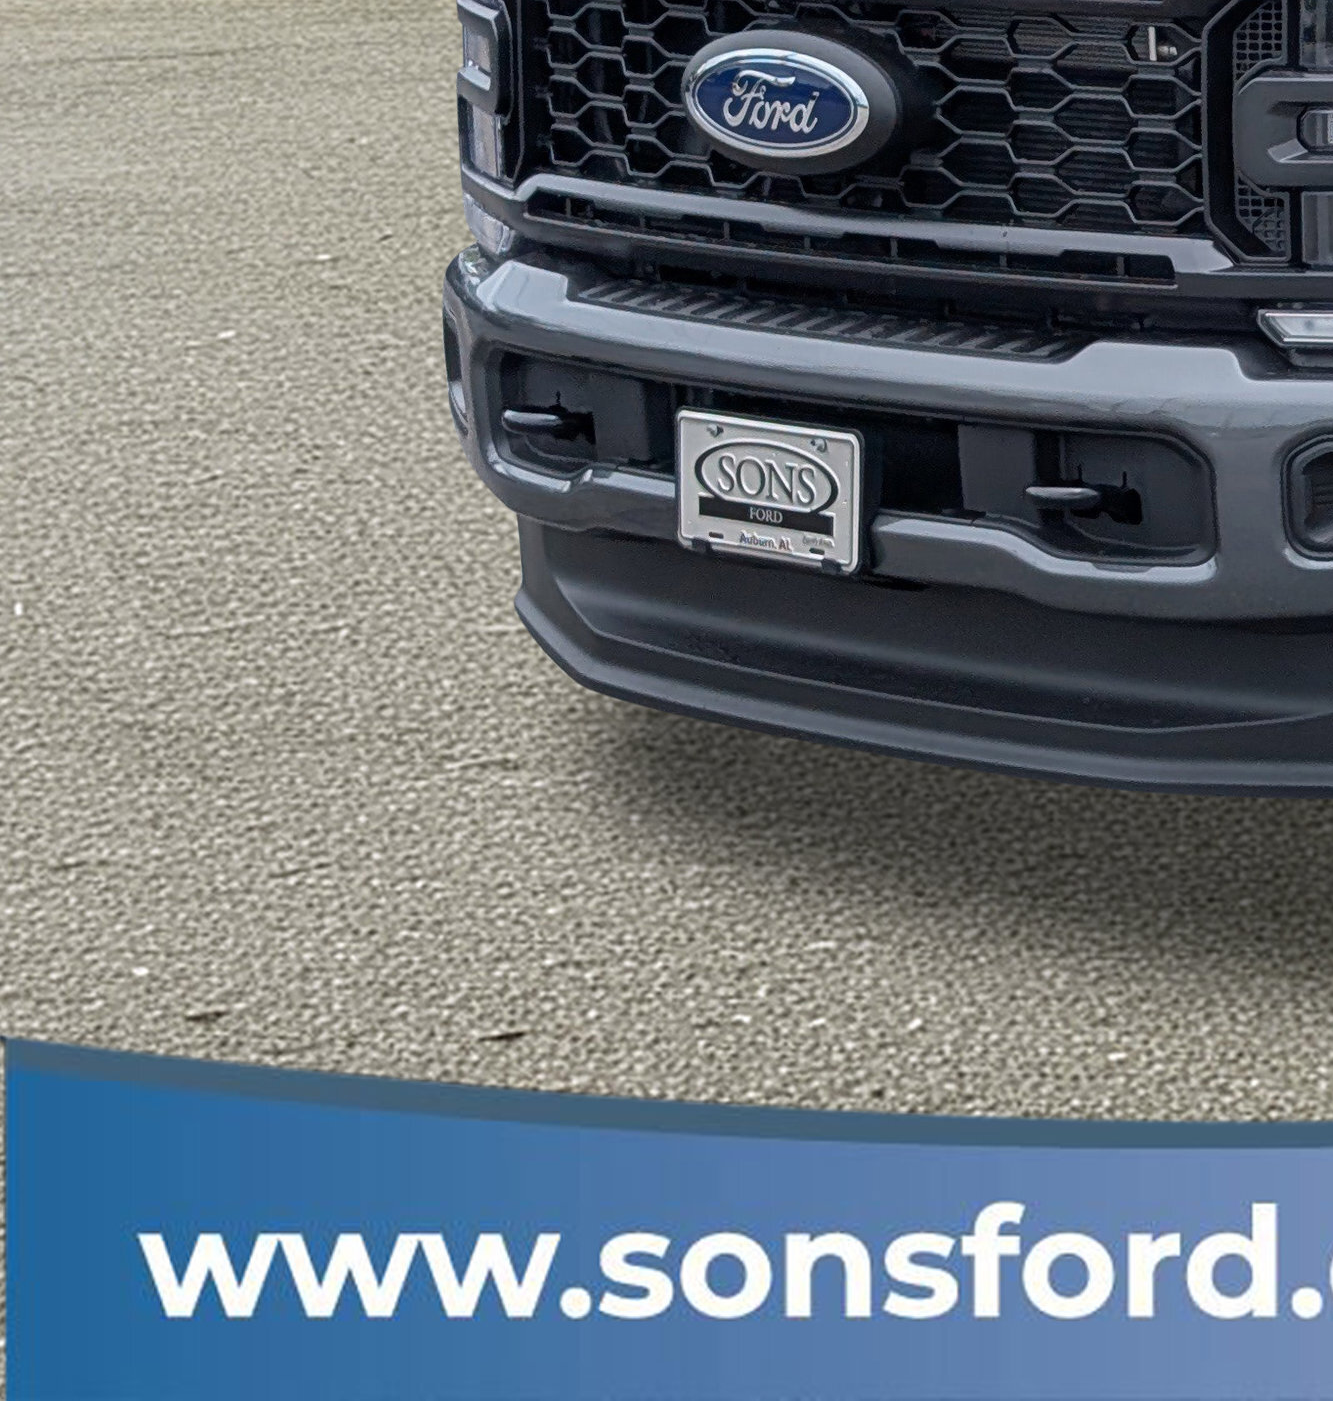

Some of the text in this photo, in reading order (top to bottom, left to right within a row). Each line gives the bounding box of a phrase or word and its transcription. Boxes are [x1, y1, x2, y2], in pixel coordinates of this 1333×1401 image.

[722, 69, 820, 134] Ford
[717, 452, 817, 505] SONS
[748, 506, 784, 524] FORD
